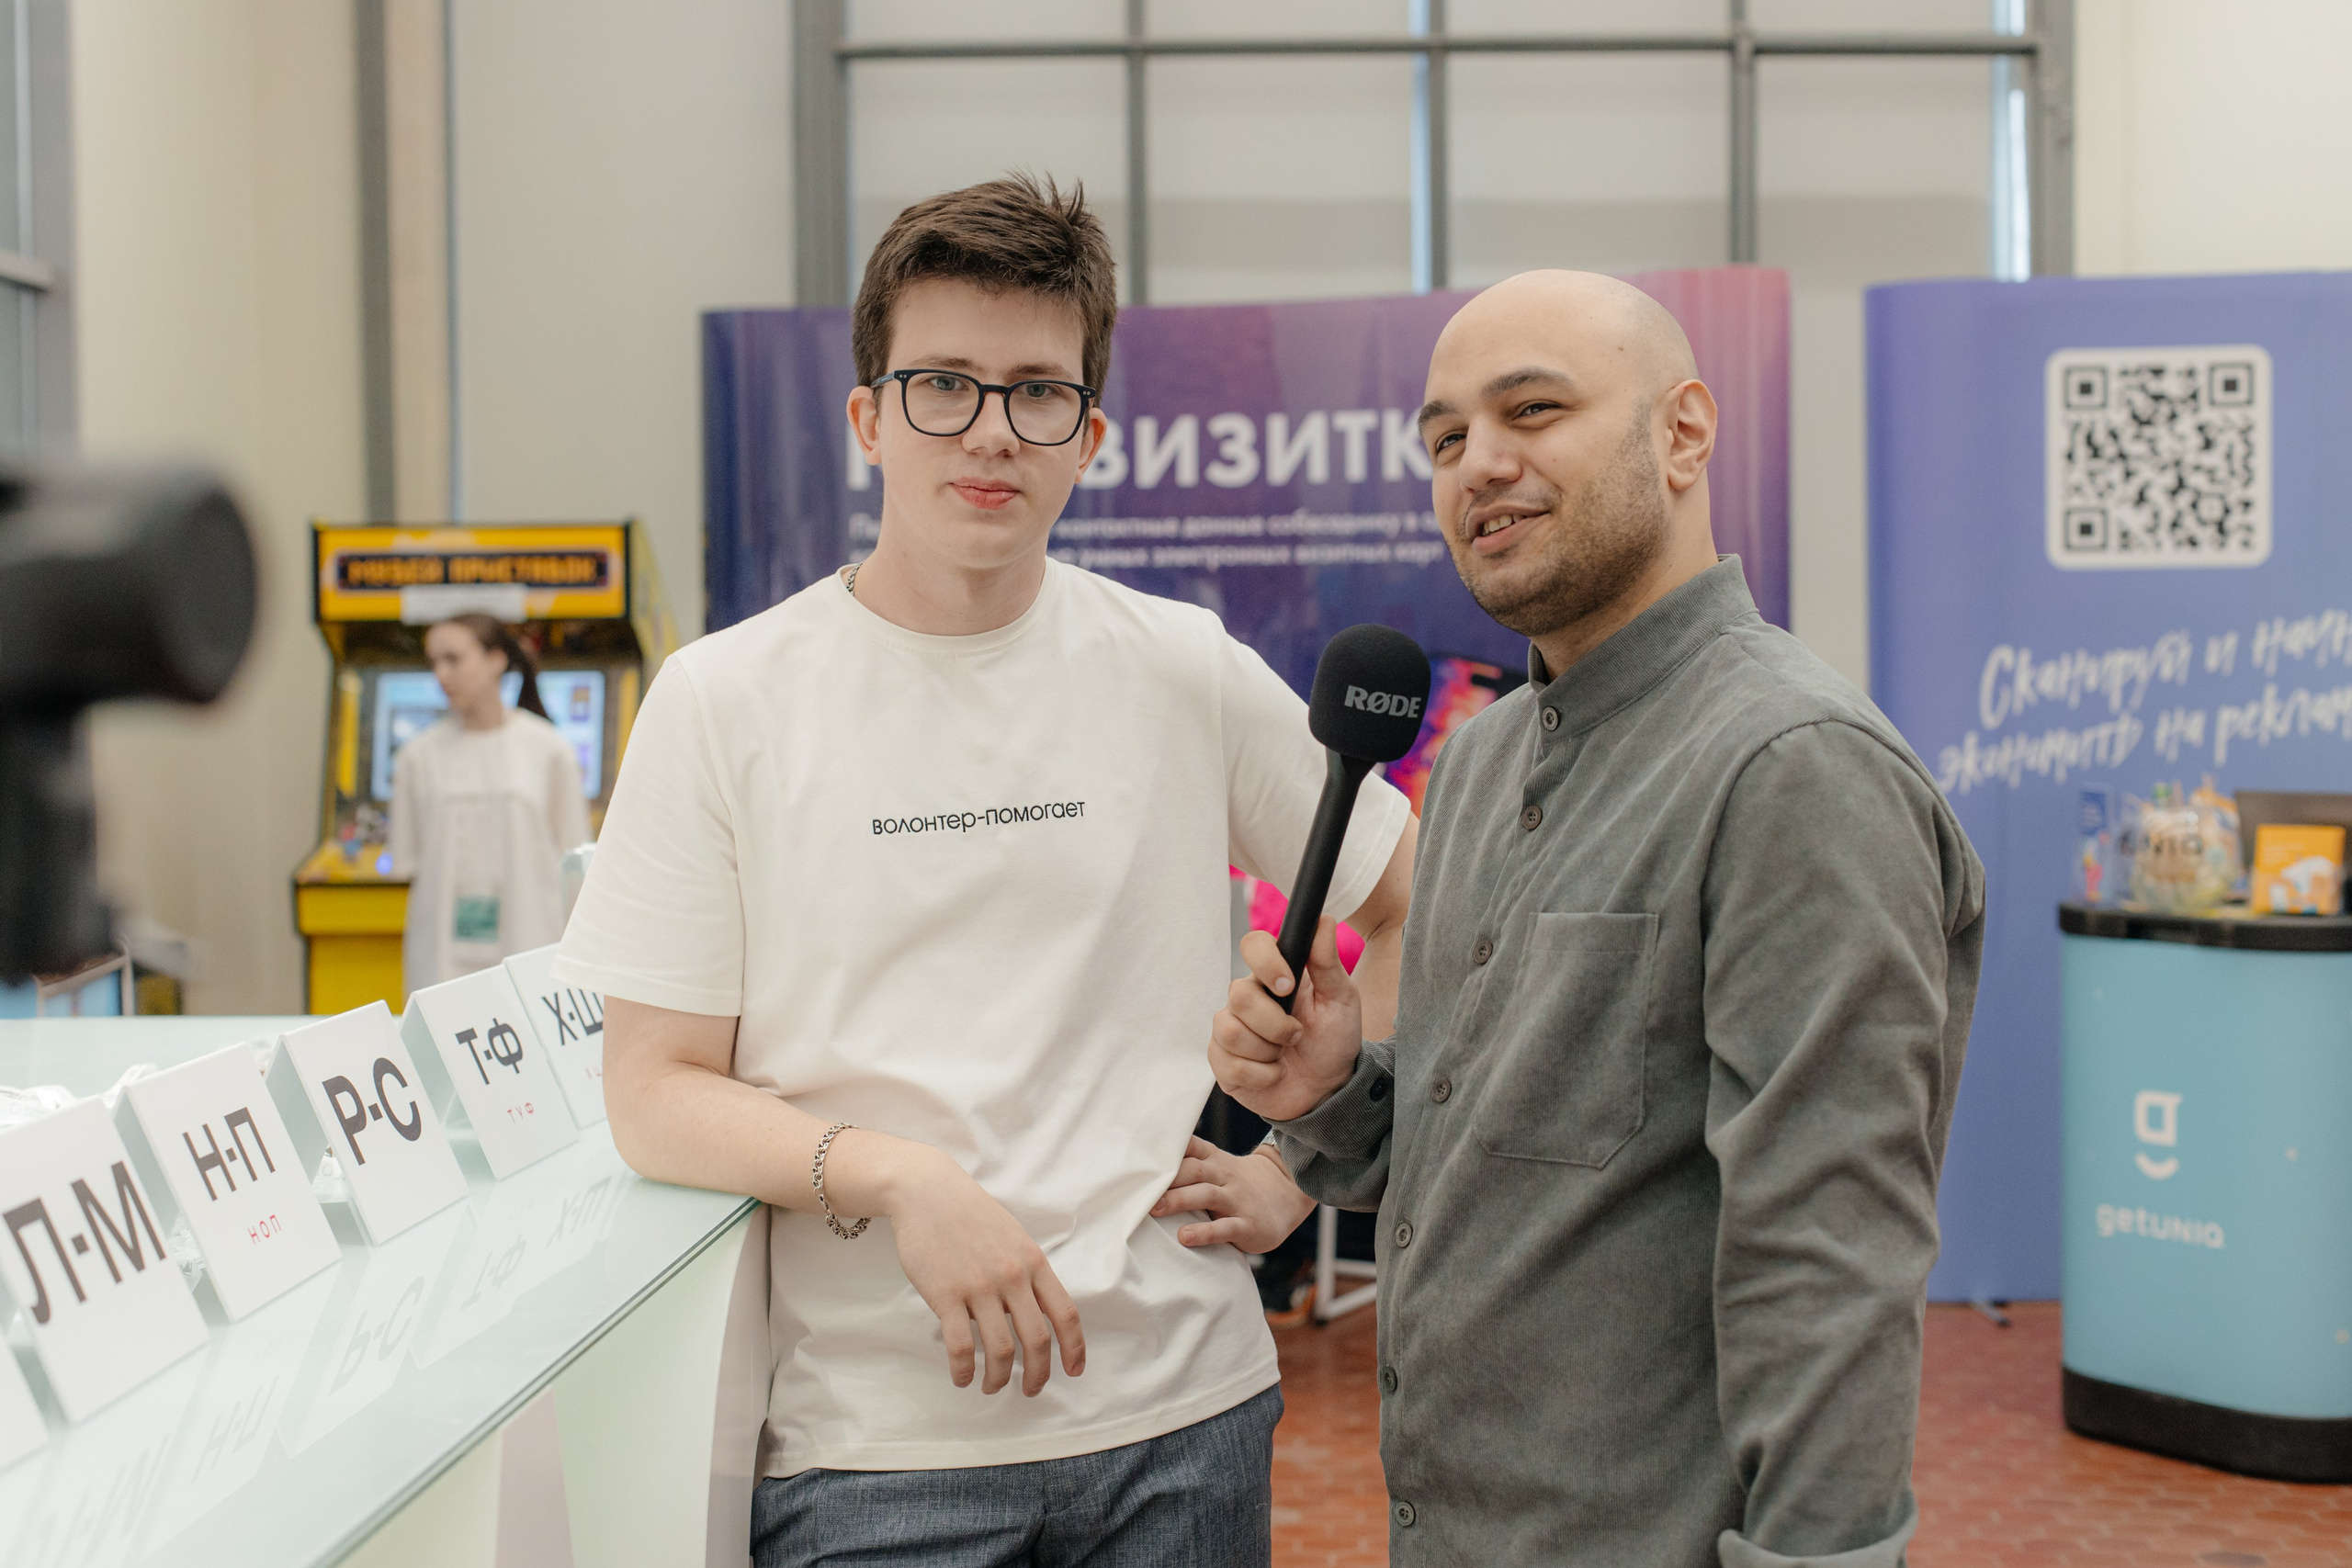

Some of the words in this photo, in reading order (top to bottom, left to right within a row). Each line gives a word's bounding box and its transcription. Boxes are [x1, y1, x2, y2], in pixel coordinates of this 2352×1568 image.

[1344, 684, 1422, 718] RØDE
[1978, 629, 2193, 730] Сканируй
[2205, 630, 2239, 678] и
[1935, 713, 2143, 795] экономить
[2154, 706, 2207, 765] на
[872, 801, 1086, 835] волонтер-помогает
